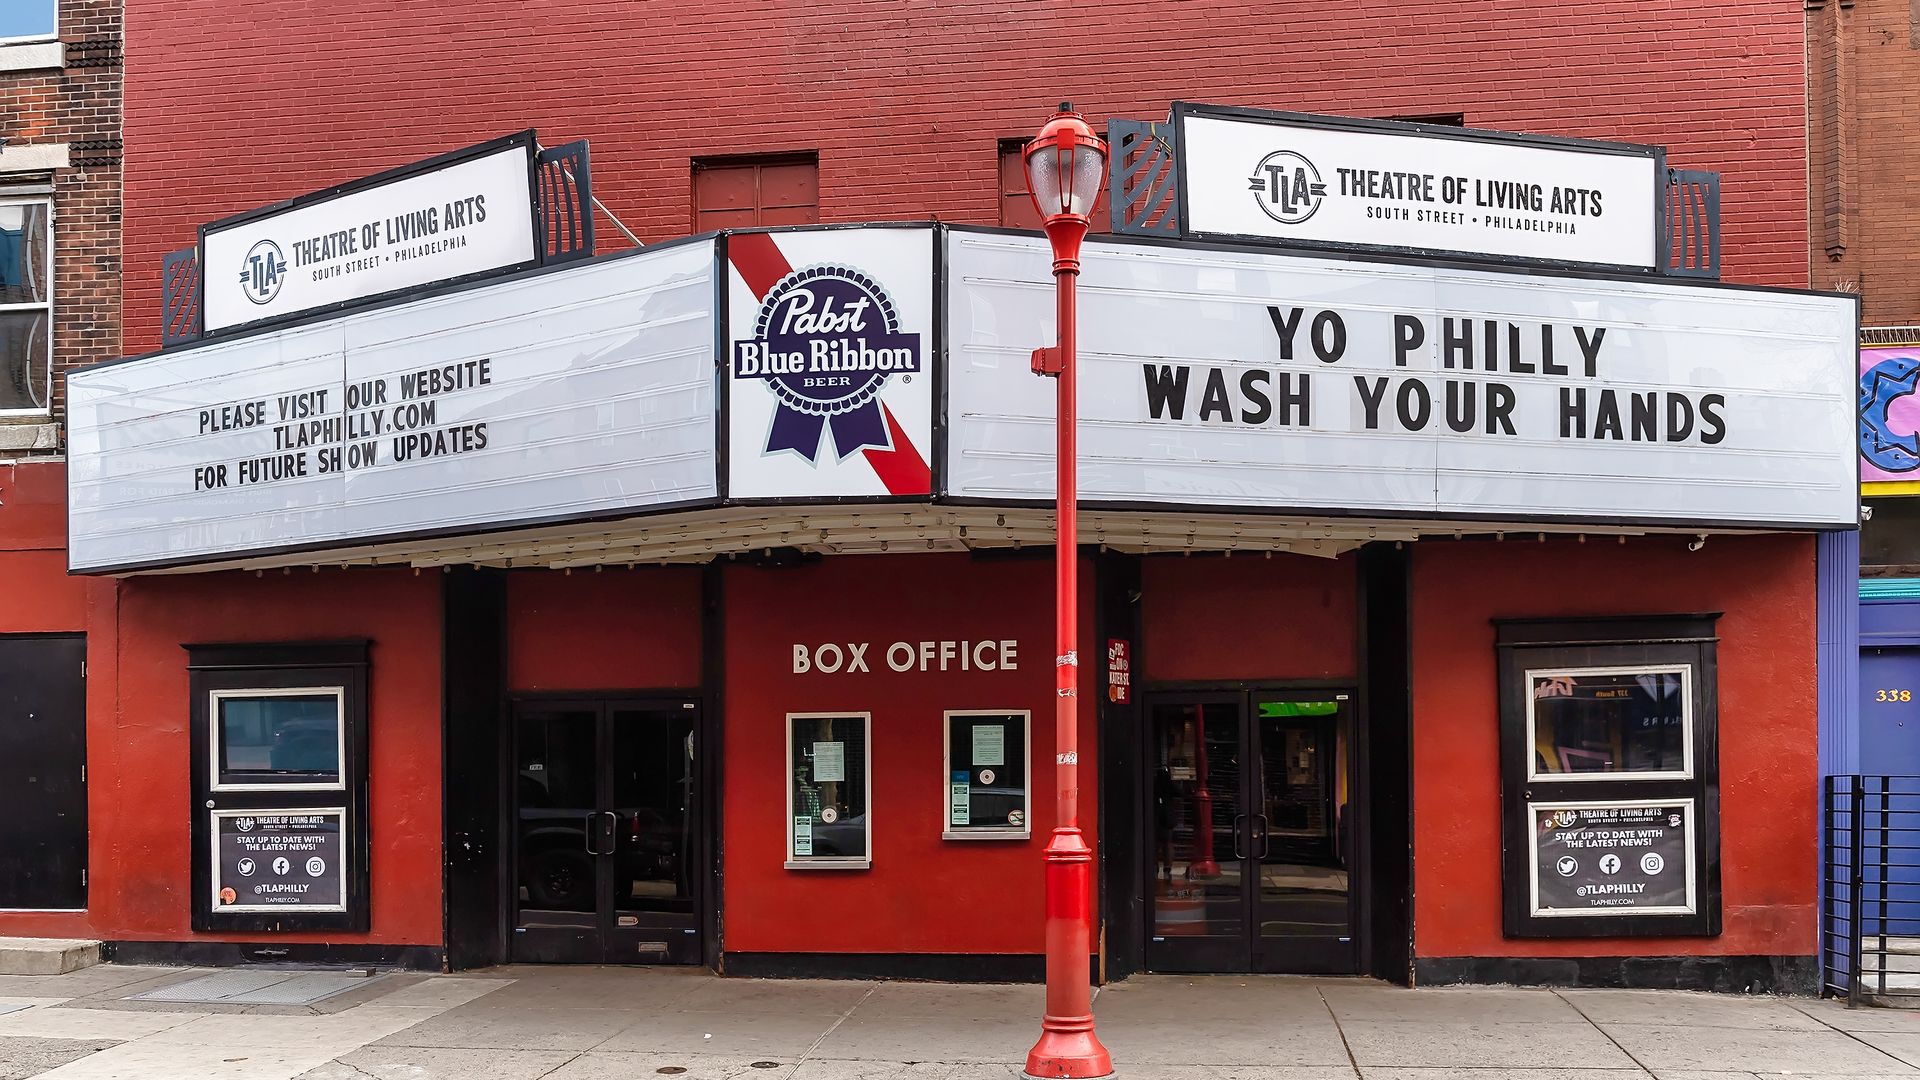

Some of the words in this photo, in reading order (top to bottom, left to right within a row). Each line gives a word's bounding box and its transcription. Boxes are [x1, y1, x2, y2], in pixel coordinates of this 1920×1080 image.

[1264, 164, 1311, 215] TLA
[1336, 167, 1435, 203] THEATRE
[1441, 175, 1468, 205] OF
[1475, 178, 1543, 212] LIVING
[1550, 186, 1603, 218] ARTS
[292, 227, 359, 268] THEATRE
[361, 221, 382, 251] OF
[386, 206, 439, 245] LIVING
[444, 194, 486, 232] ARTS
[1366, 205, 1409, 221] SOUTH
[1417, 209, 1465, 226] STREET
[1485, 215, 1576, 235] PHILADELPHIA
[312, 264, 341, 282] SOUTH
[345, 255, 380, 275] STREET
[394, 234, 467, 263] PHILADELPHIA
[249, 251, 278, 296] TLA
[778, 288, 871, 335] Pabst
[738, 341, 805, 376] Blue
[808, 337, 915, 373] Ribbon
[1267, 305, 1347, 364] YO
[1393, 314, 1607, 378] PHILLY
[199, 401, 266, 434] PLEASE
[277, 389, 328, 421] VISIT
[346, 379, 387, 407] OUR
[400, 358, 491, 400] WEBSITE
[803, 376, 851, 387] BEER
[1142, 363, 1310, 427] WASH
[1353, 375, 1518, 436] YOUR
[1559, 387, 1726, 445] HANDS
[194, 464, 228, 491] FOR
[238, 452, 307, 485] FUTURE
[317, 440, 378, 474] SHOW
[393, 422, 487, 462] UPDATES
[793, 642, 871, 674] BOX
[886, 639, 1018, 672] OFFICE
[1875, 688, 1912, 703] 338
[240, 816, 251, 830] TLA
[256, 816, 281, 825] THEATRE
[281, 816, 289, 824] OF
[289, 816, 308, 824] LIVING
[309, 816, 324, 824] ARTS
[1557, 810, 1572, 825] TLA
[1579, 810, 1609, 819] THEATRE
[1609, 809, 1619, 818] OF
[1620, 808, 1643, 817] LIVING
[1644, 808, 1662, 816] ARTS
[236, 836, 256, 844] STAY
[257, 836, 268, 844] UP
[303, 835, 325, 843] WITH
[246, 843, 260, 851] THE
[262, 843, 287, 851] LATEST
[1555, 832, 1579, 841] STAY
[1581, 832, 1595, 840] UP
[1596, 831, 1610, 839] TO
[1612, 830, 1636, 839] DATE
[1638, 829, 1663, 838] WITH
[1566, 840, 1583, 848] THE
[1586, 839, 1618, 847] LATEST
[1620, 838, 1652, 847] NEWS!
[254, 884, 310, 895] @TLAPHILLY
[1576, 883, 1646, 897] @TLAPHILLY
